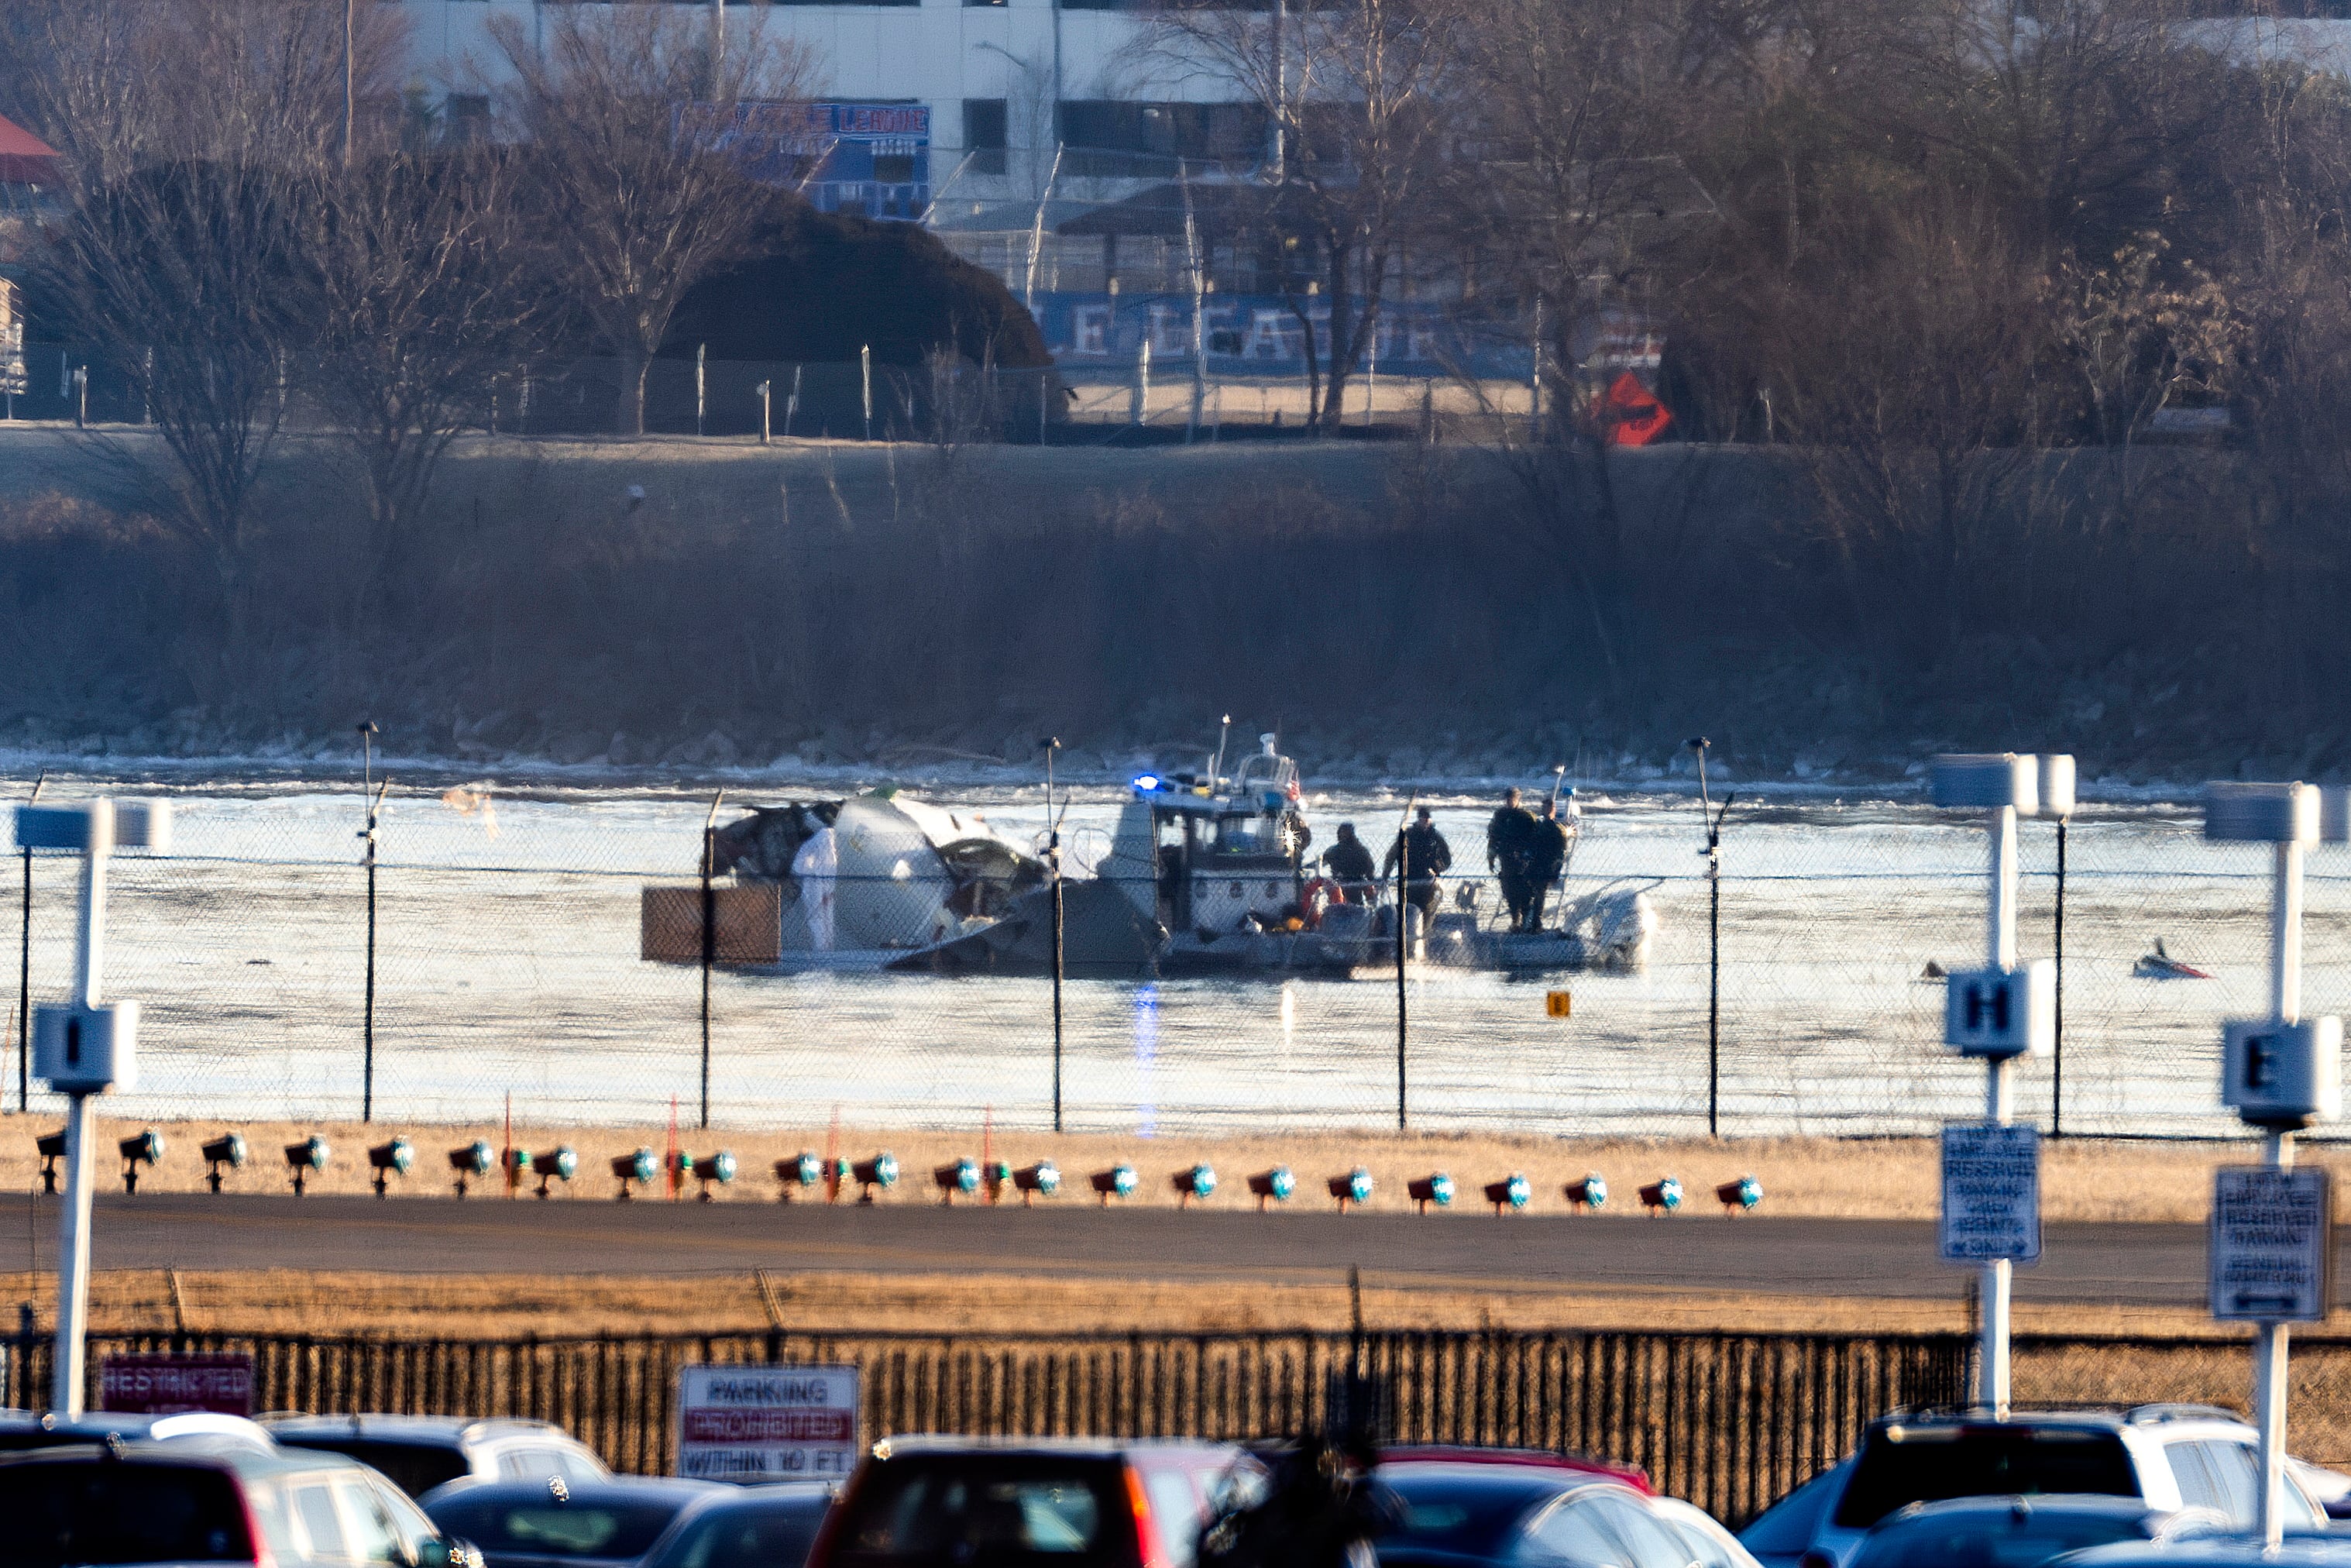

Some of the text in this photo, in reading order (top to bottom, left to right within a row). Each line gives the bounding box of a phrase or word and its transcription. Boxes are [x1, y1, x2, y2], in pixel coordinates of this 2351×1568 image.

[1964, 983, 2008, 1030] H
[2245, 1033, 2280, 1090] E
[102, 1367, 249, 1398] RESTRICTED
[706, 1377, 828, 1403] PARKING
[693, 1411, 843, 1437] PROHIBITED
[686, 1450, 765, 1473] WITHIN
[780, 1450, 806, 1471] 10
